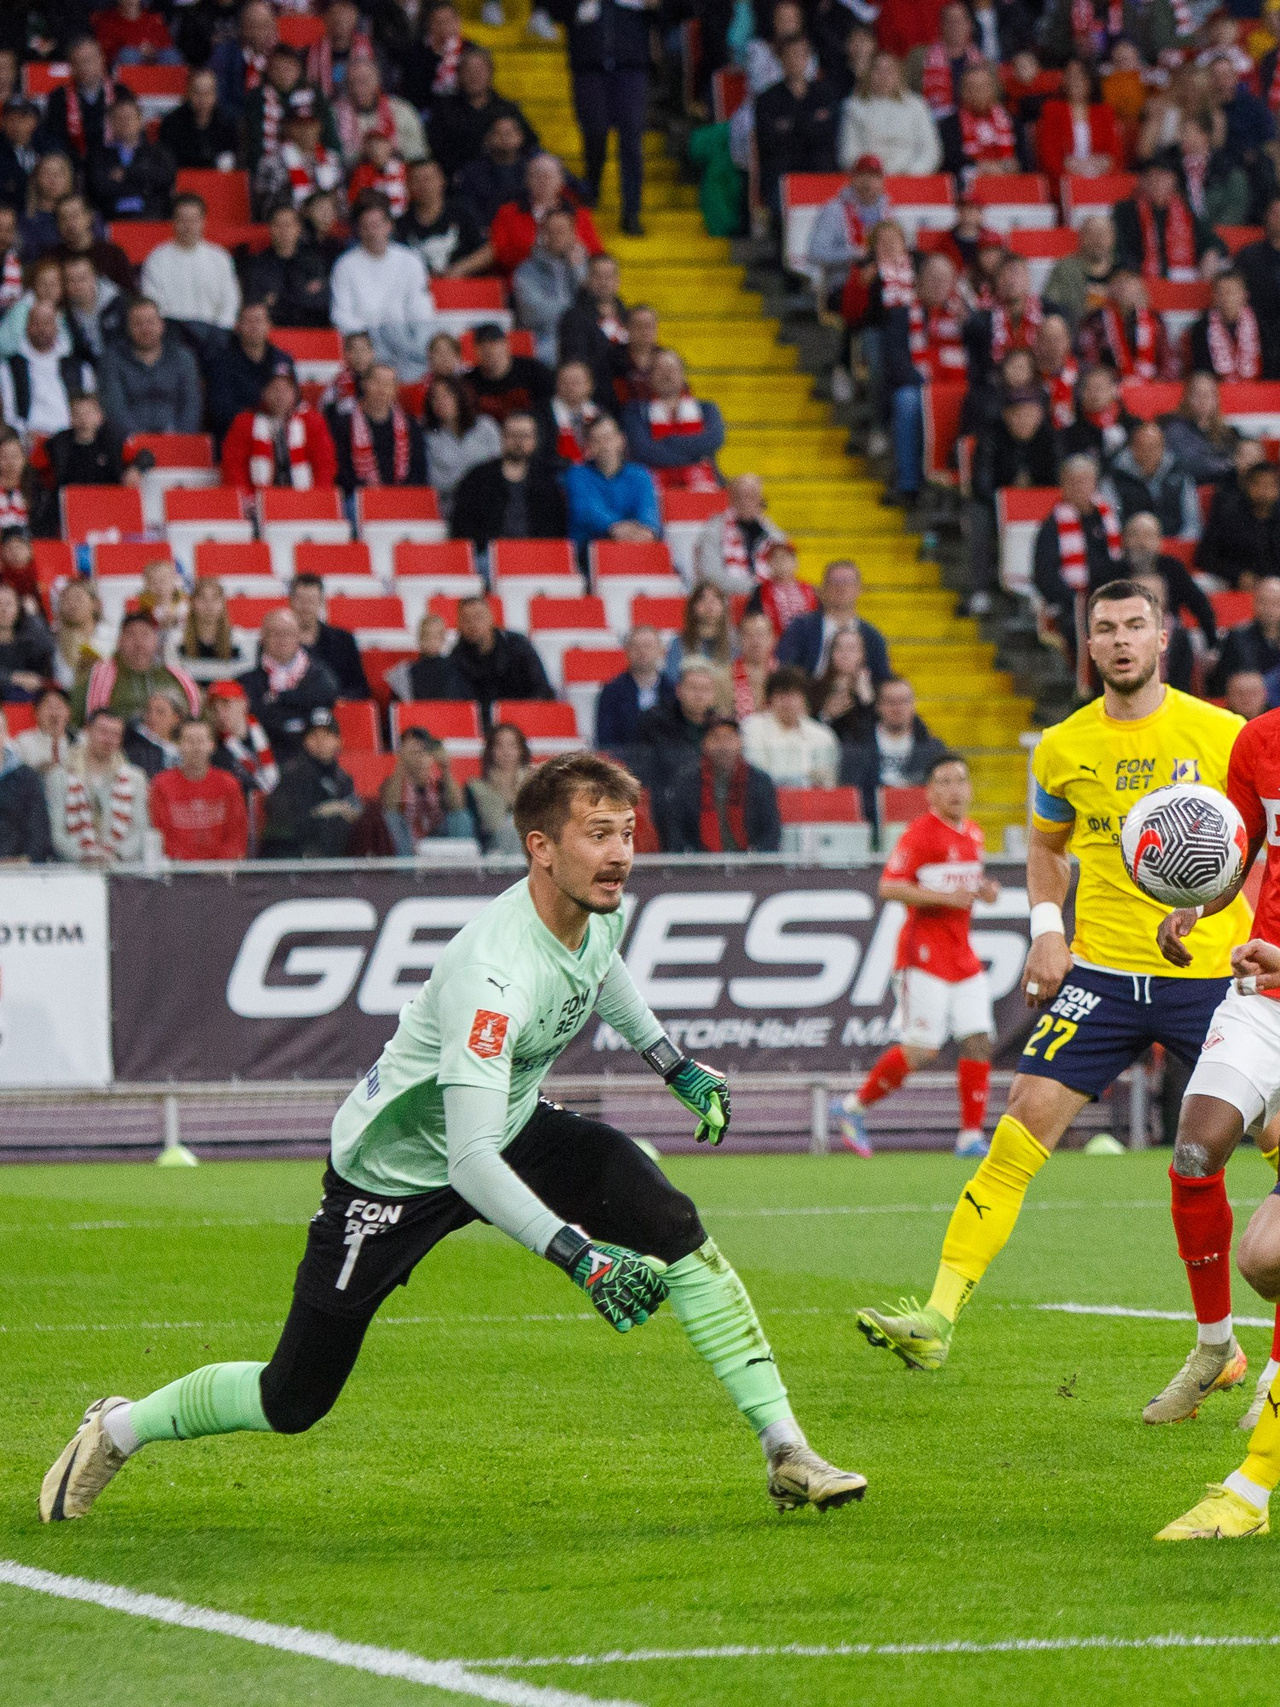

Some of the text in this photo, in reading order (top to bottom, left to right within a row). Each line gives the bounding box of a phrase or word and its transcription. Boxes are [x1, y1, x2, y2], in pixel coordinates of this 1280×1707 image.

[1116, 759, 1155, 774] FON
[1116, 775, 1153, 791] BET
[1088, 815, 1111, 832] ФК
[226, 888, 1030, 1018] GEESIS
[561, 988, 591, 1018] FON
[1050, 998, 1091, 1021] BET
[1058, 985, 1101, 1010] FON
[552, 1009, 585, 1039] BET
[593, 1017, 833, 1049] МТОРНЫЕ
[1022, 1014, 1078, 1061] 27
[345, 1199, 403, 1224] FON
[335, 1233, 366, 1290] 1
